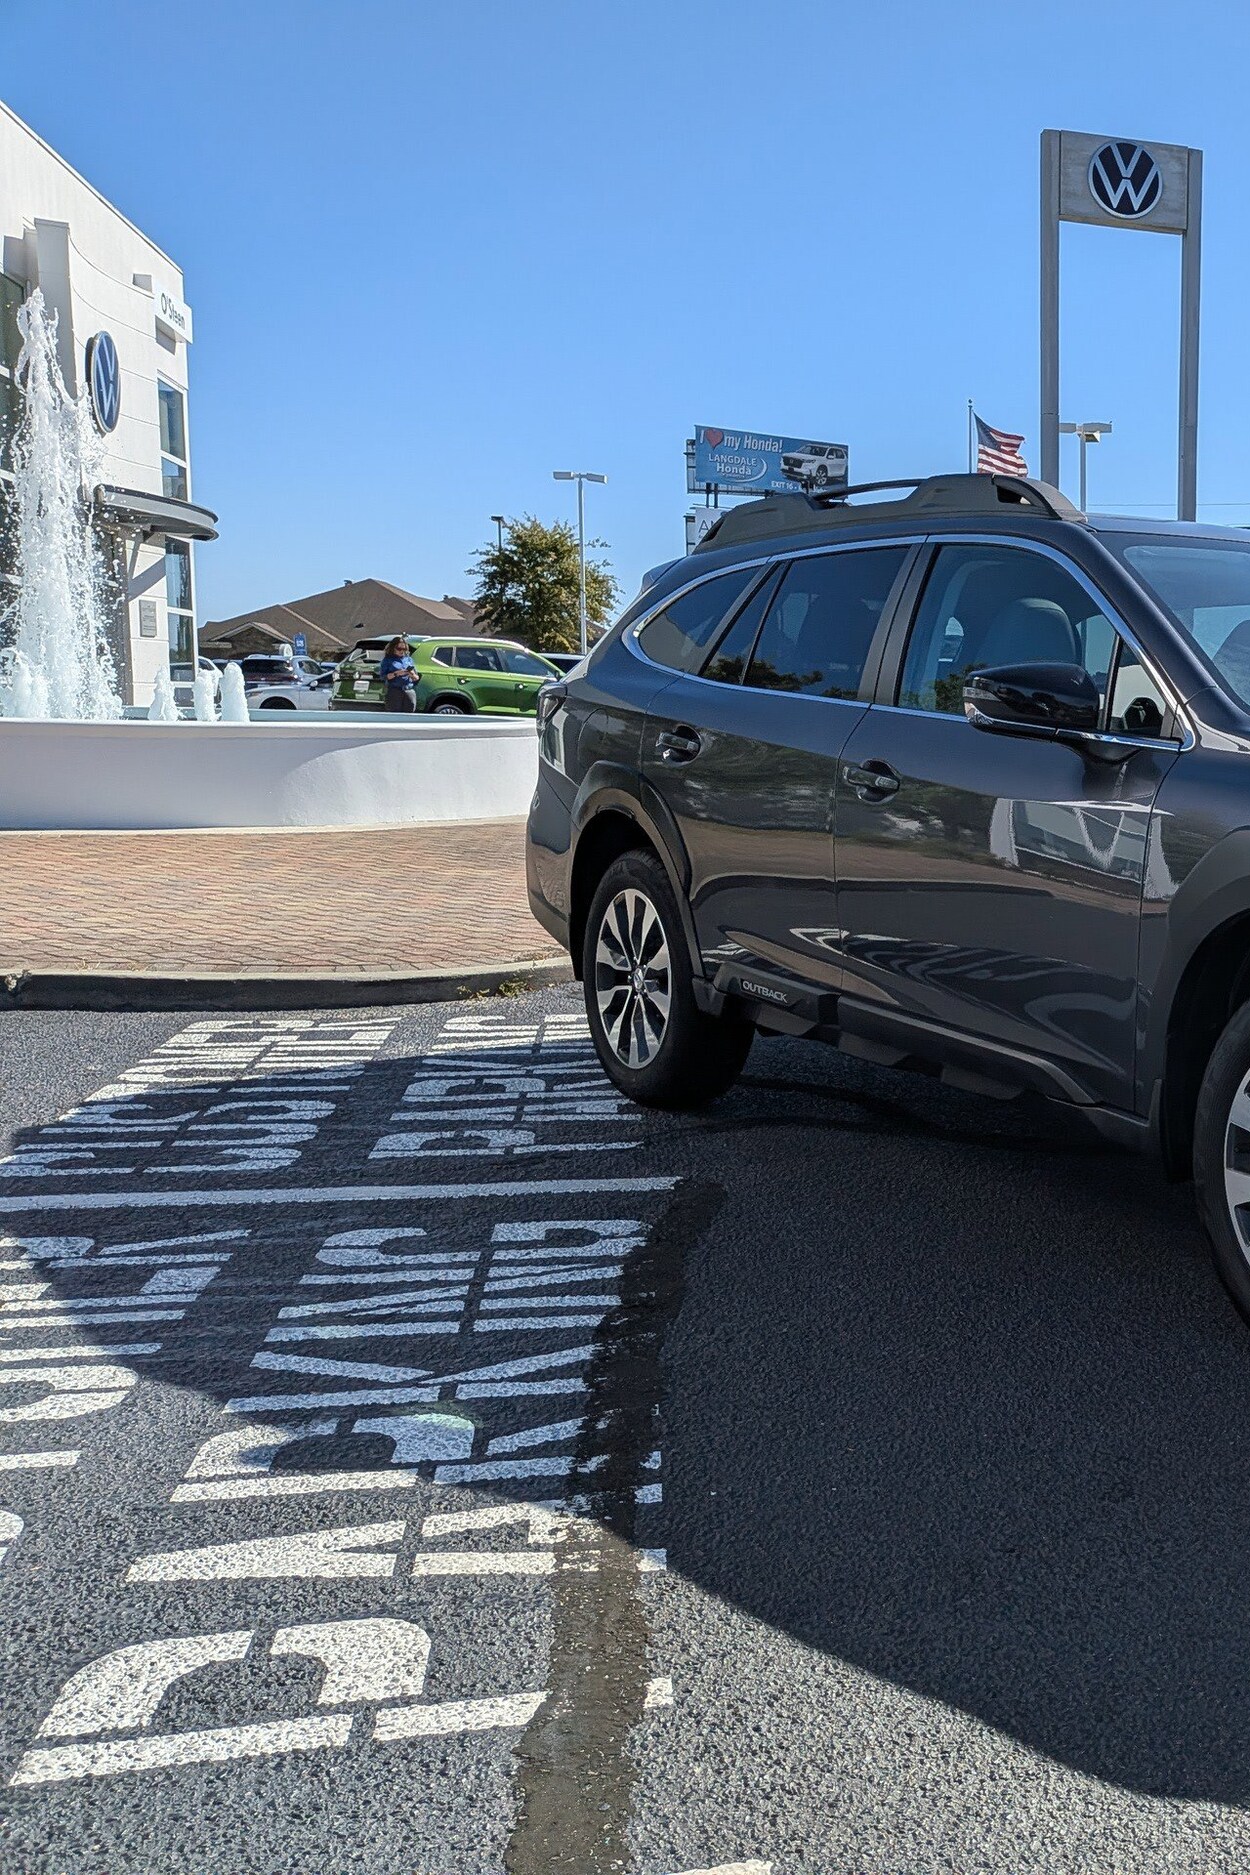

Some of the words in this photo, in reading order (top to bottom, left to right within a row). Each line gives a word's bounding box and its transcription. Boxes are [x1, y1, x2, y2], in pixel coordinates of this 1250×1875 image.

[1091, 142, 1161, 213] VW
[160, 292, 186, 330] O'Steen
[700, 429, 705, 444] I
[724, 434, 741, 451] my
[744, 434, 783, 453] Honda!
[708, 453, 758, 467] LANGDALE
[716, 462, 752, 475] Honda
[771, 480, 786, 488] EXIT
[742, 980, 788, 1004] OUTBACK
[0, 1017, 402, 1178] CUSTOMER
[369, 1013, 645, 1160] PARKING
[9, 1218, 673, 1787] PARKING
